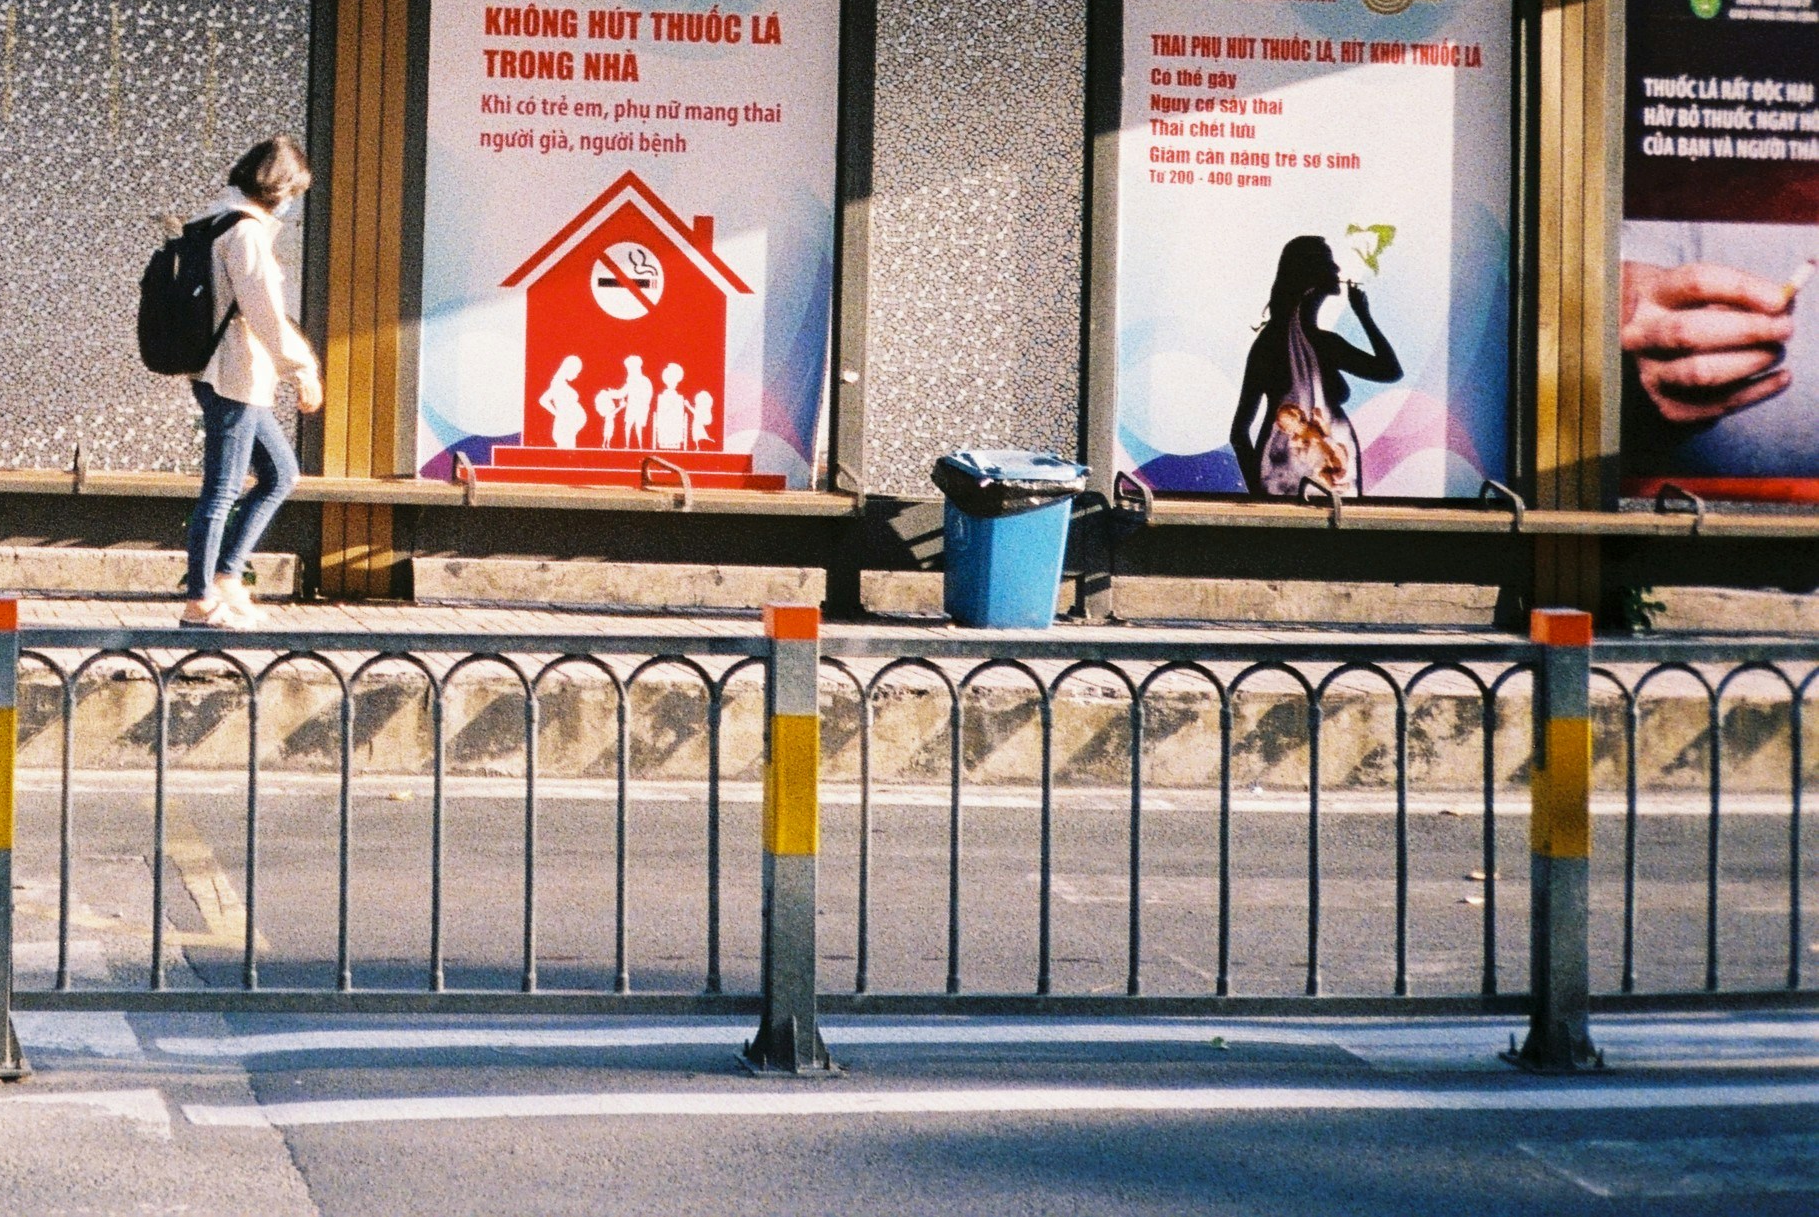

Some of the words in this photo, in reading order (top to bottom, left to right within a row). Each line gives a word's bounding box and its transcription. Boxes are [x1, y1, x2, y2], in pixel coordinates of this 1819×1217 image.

[484, 3, 579, 41] KHÔNG
[587, 1, 642, 42] HÚT
[650, 4, 742, 45] THUỐC
[751, 11, 782, 45] LÁ
[483, 49, 574, 82] TRONG
[583, 49, 640, 83] NHÀ
[1151, 33, 1187, 57] THAI
[1191, 35, 1222, 63] PHỤ
[1226, 33, 1257, 60] HÚT
[1464, 41, 1484, 69] LÁ
[1150, 67, 1172, 86] Có
[1176, 66, 1203, 87] thể
[1207, 70, 1237, 90] gây
[1643, 73, 1697, 99] THUỐC
[1699, 76, 1718, 100] LÁ
[481, 94, 511, 115] Khi
[516, 95, 537, 115] có
[541, 94, 569, 117] trẻ
[573, 100, 610, 122] em,
[613, 99, 650, 125] phụ
[655, 100, 682, 120] nữ
[684, 105, 740, 127] mang
[742, 101, 783, 124] thai
[1150, 93, 1191, 113] Nguy
[1195, 96, 1216, 113] cơ
[1252, 97, 1283, 115] thai
[1643, 102, 1676, 127] HÃY
[1702, 104, 1755, 130] THUỐC
[1755, 111, 1797, 132] NGAY
[480, 127, 534, 150] người
[538, 128, 576, 153] già,
[580, 130, 634, 153] người
[638, 131, 687, 159] bệnh
[1149, 118, 1185, 137] Thai
[1230, 121, 1256, 139] lưu
[1275, 147, 1298, 168] trẻ
[1303, 151, 1323, 169] sơ
[1326, 152, 1361, 169] sinh
[1643, 131, 1675, 156] CỦA
[1677, 136, 1711, 162] BẠN
[1169, 169, 1195, 185] 200
[1207, 170, 1233, 186] 400
[1237, 174, 1272, 188] gram
